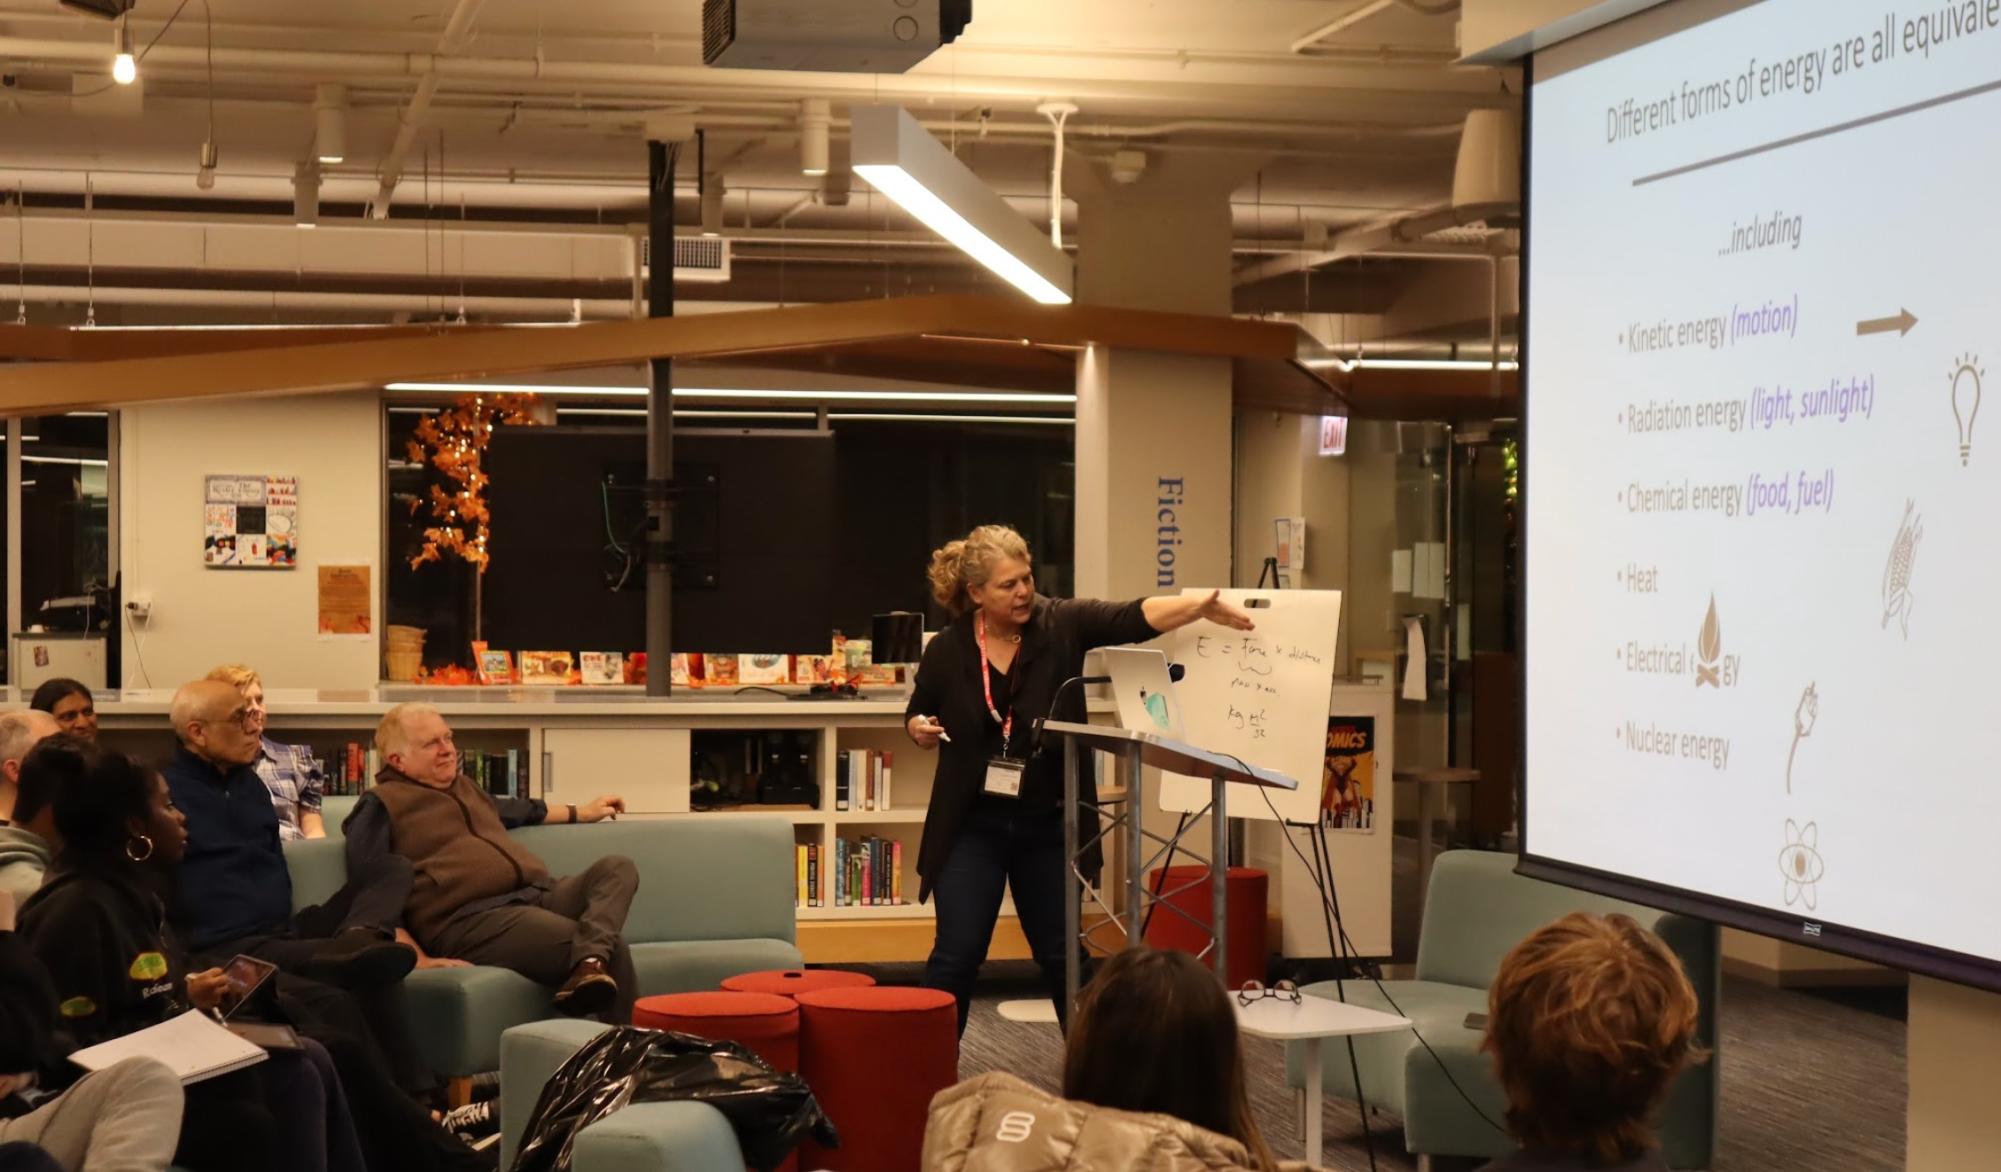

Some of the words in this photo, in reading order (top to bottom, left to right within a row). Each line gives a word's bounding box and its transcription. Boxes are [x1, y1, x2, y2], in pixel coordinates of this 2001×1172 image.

[1607, 90, 1677, 144] Different
[1681, 78, 1731, 121] forms
[1736, 58, 1756, 104] of
[1760, 48, 1827, 97] energy
[1832, 36, 1866, 76] are
[1871, 12, 1896, 63] all
[1628, 319, 1675, 353] Kinetic
[1678, 316, 1727, 350] energy
[1731, 293, 1799, 346] (motion)
[1628, 400, 1692, 434] Radiation
[1696, 399, 1747, 432] energy
[1750, 385, 1796, 430] (light,
[1800, 373, 1875, 423] sunlight)
[1627, 477, 1689, 513] Chemical
[1692, 483, 1743, 518] energy
[1747, 471, 1792, 516] (food,
[1794, 468, 1835, 515] fuel)
[1157, 477, 1184, 588] Fiction
[1627, 562, 1659, 593] Heat
[1627, 640, 1686, 675] Electrical
[1327, 731, 1367, 748] OMICS
[1626, 720, 1678, 757] Nuclear
[1681, 733, 1730, 771] energy
